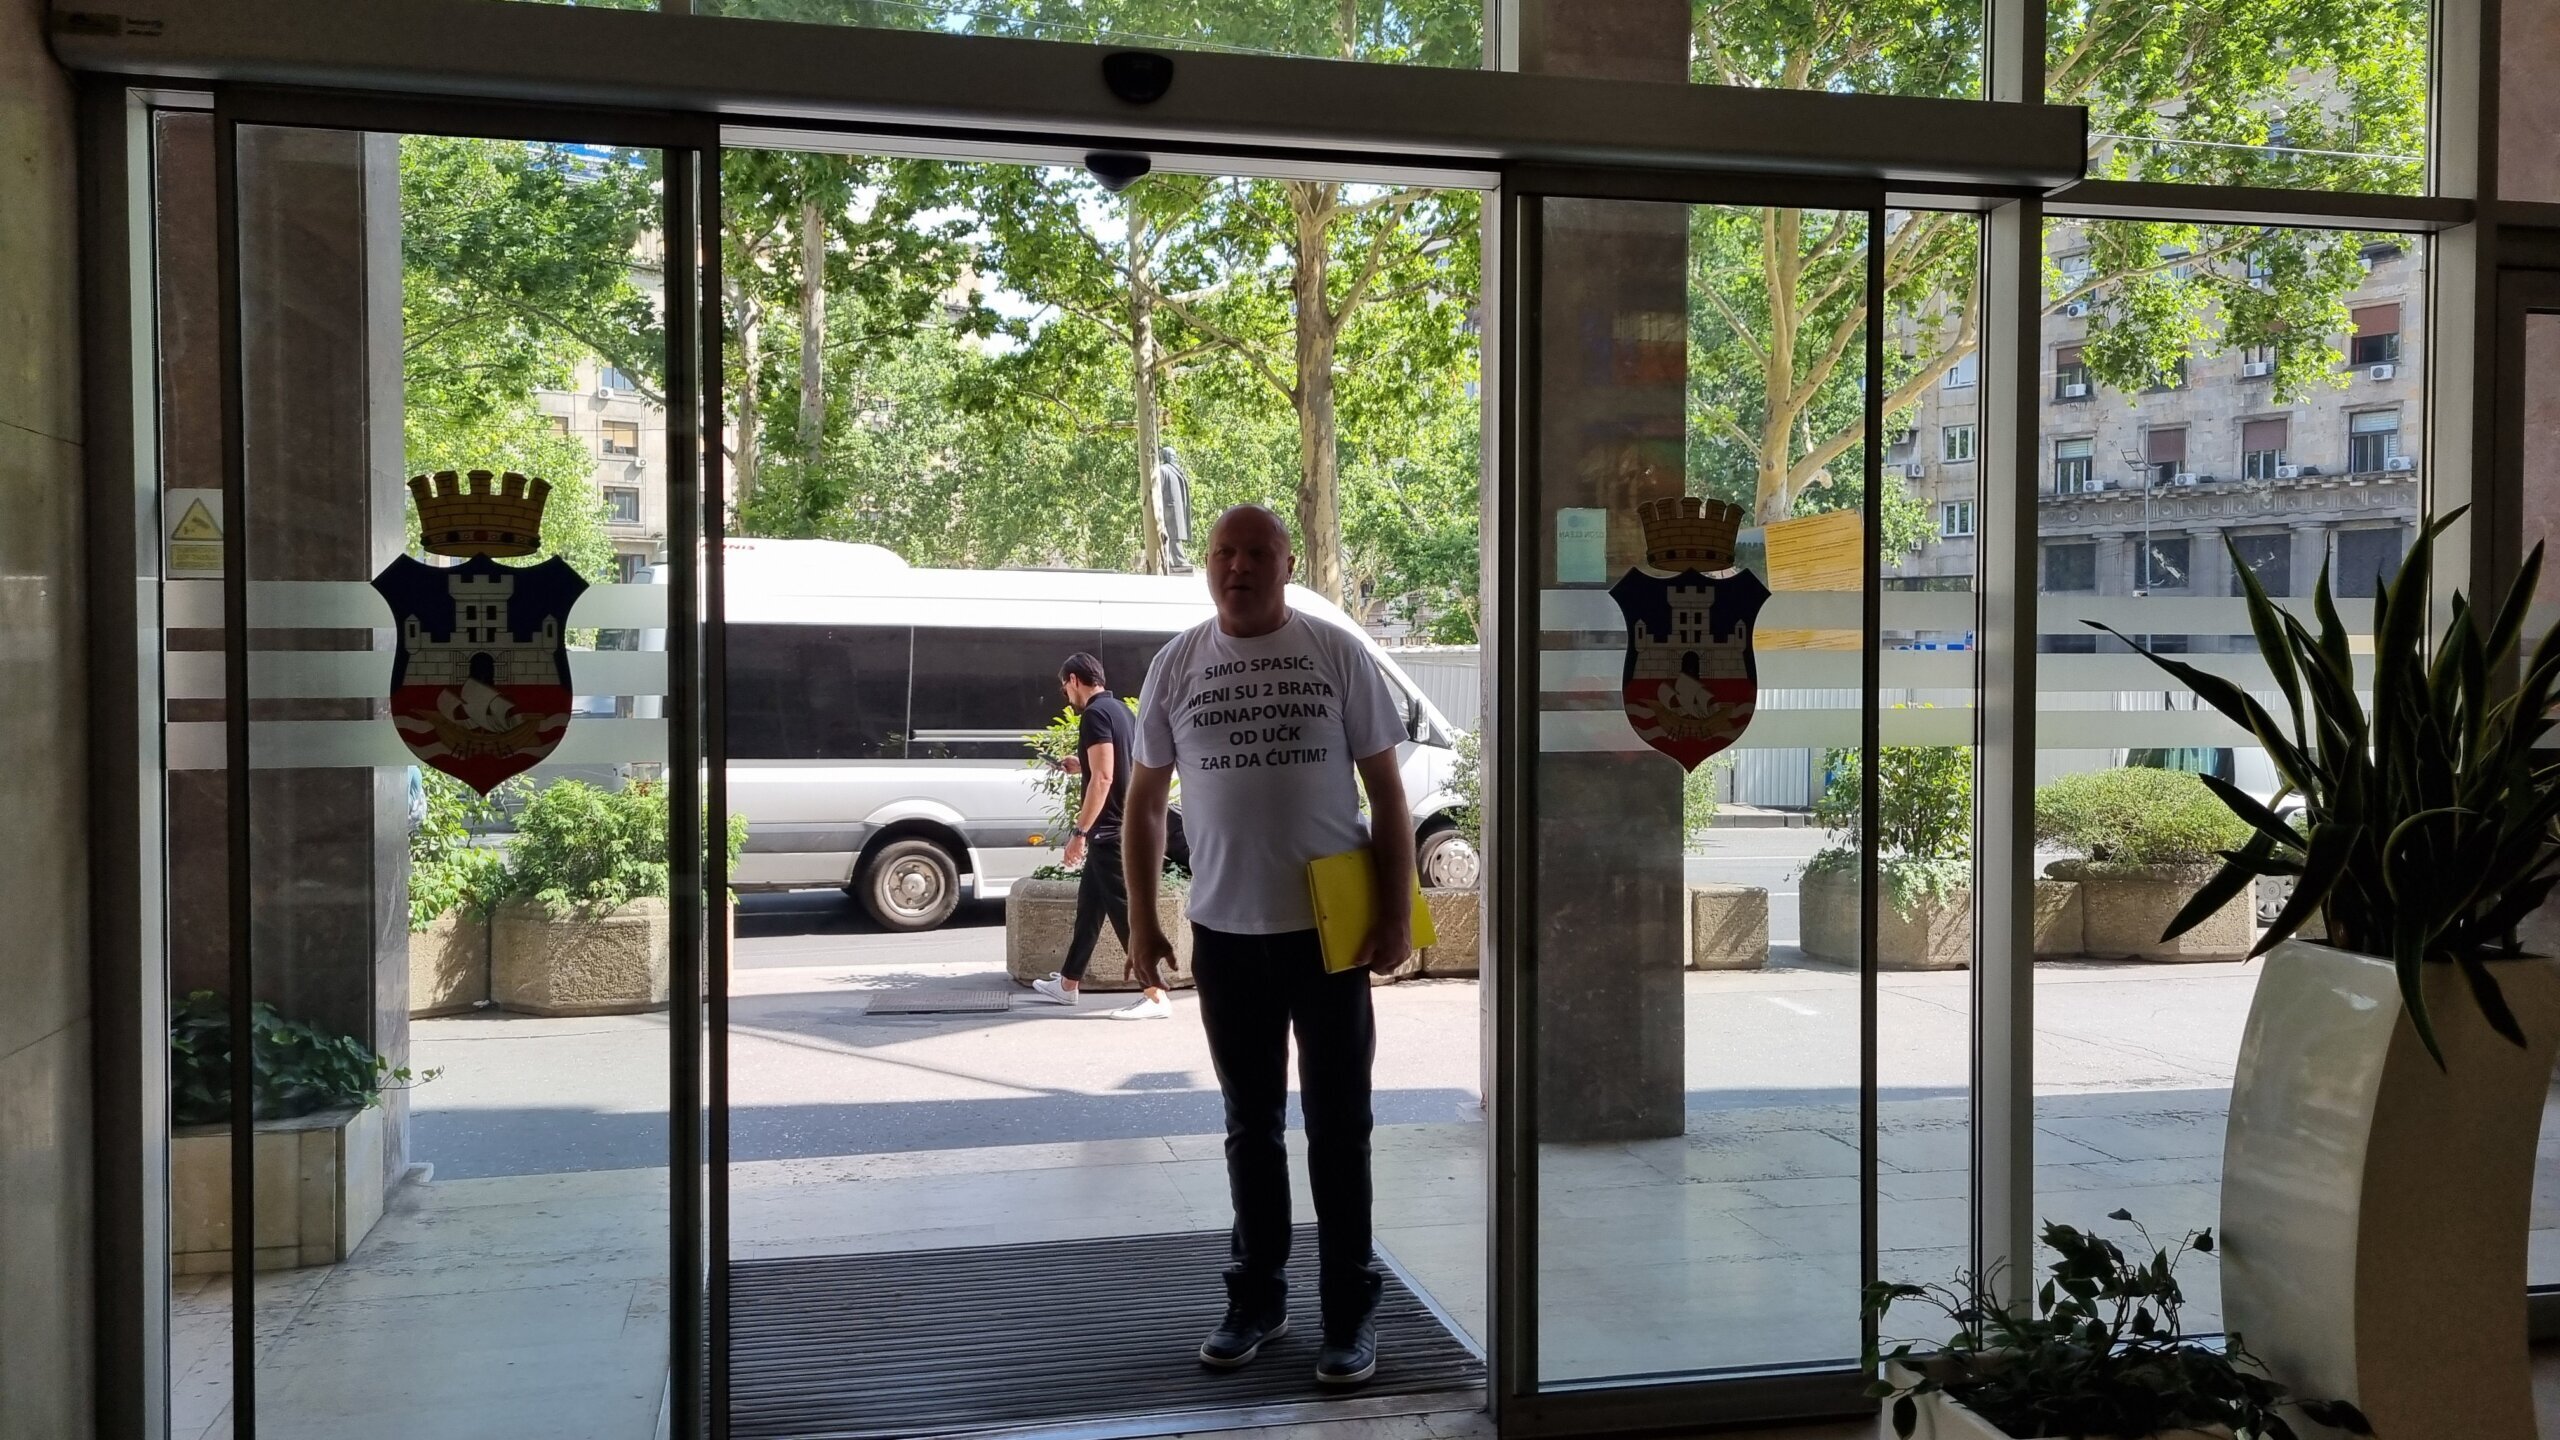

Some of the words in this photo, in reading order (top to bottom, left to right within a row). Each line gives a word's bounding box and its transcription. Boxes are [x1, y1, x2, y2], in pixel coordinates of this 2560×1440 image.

[1205, 660, 1246, 680] SIMO
[1250, 655, 1314, 672] SPASIĆ:
[1188, 687, 1230, 709] MENI
[1234, 684, 1258, 700] SU
[1262, 683, 1274, 697] 2
[1278, 681, 1334, 698] BRATA
[1193, 703, 1329, 728] KIDNAPOVANA
[1230, 730, 1258, 746] OD
[1262, 724, 1302, 743] UČK
[1200, 755, 1231, 770] ZAR
[1235, 753, 1262, 769] DA
[1265, 748, 1327, 766] ĆUTIM?
